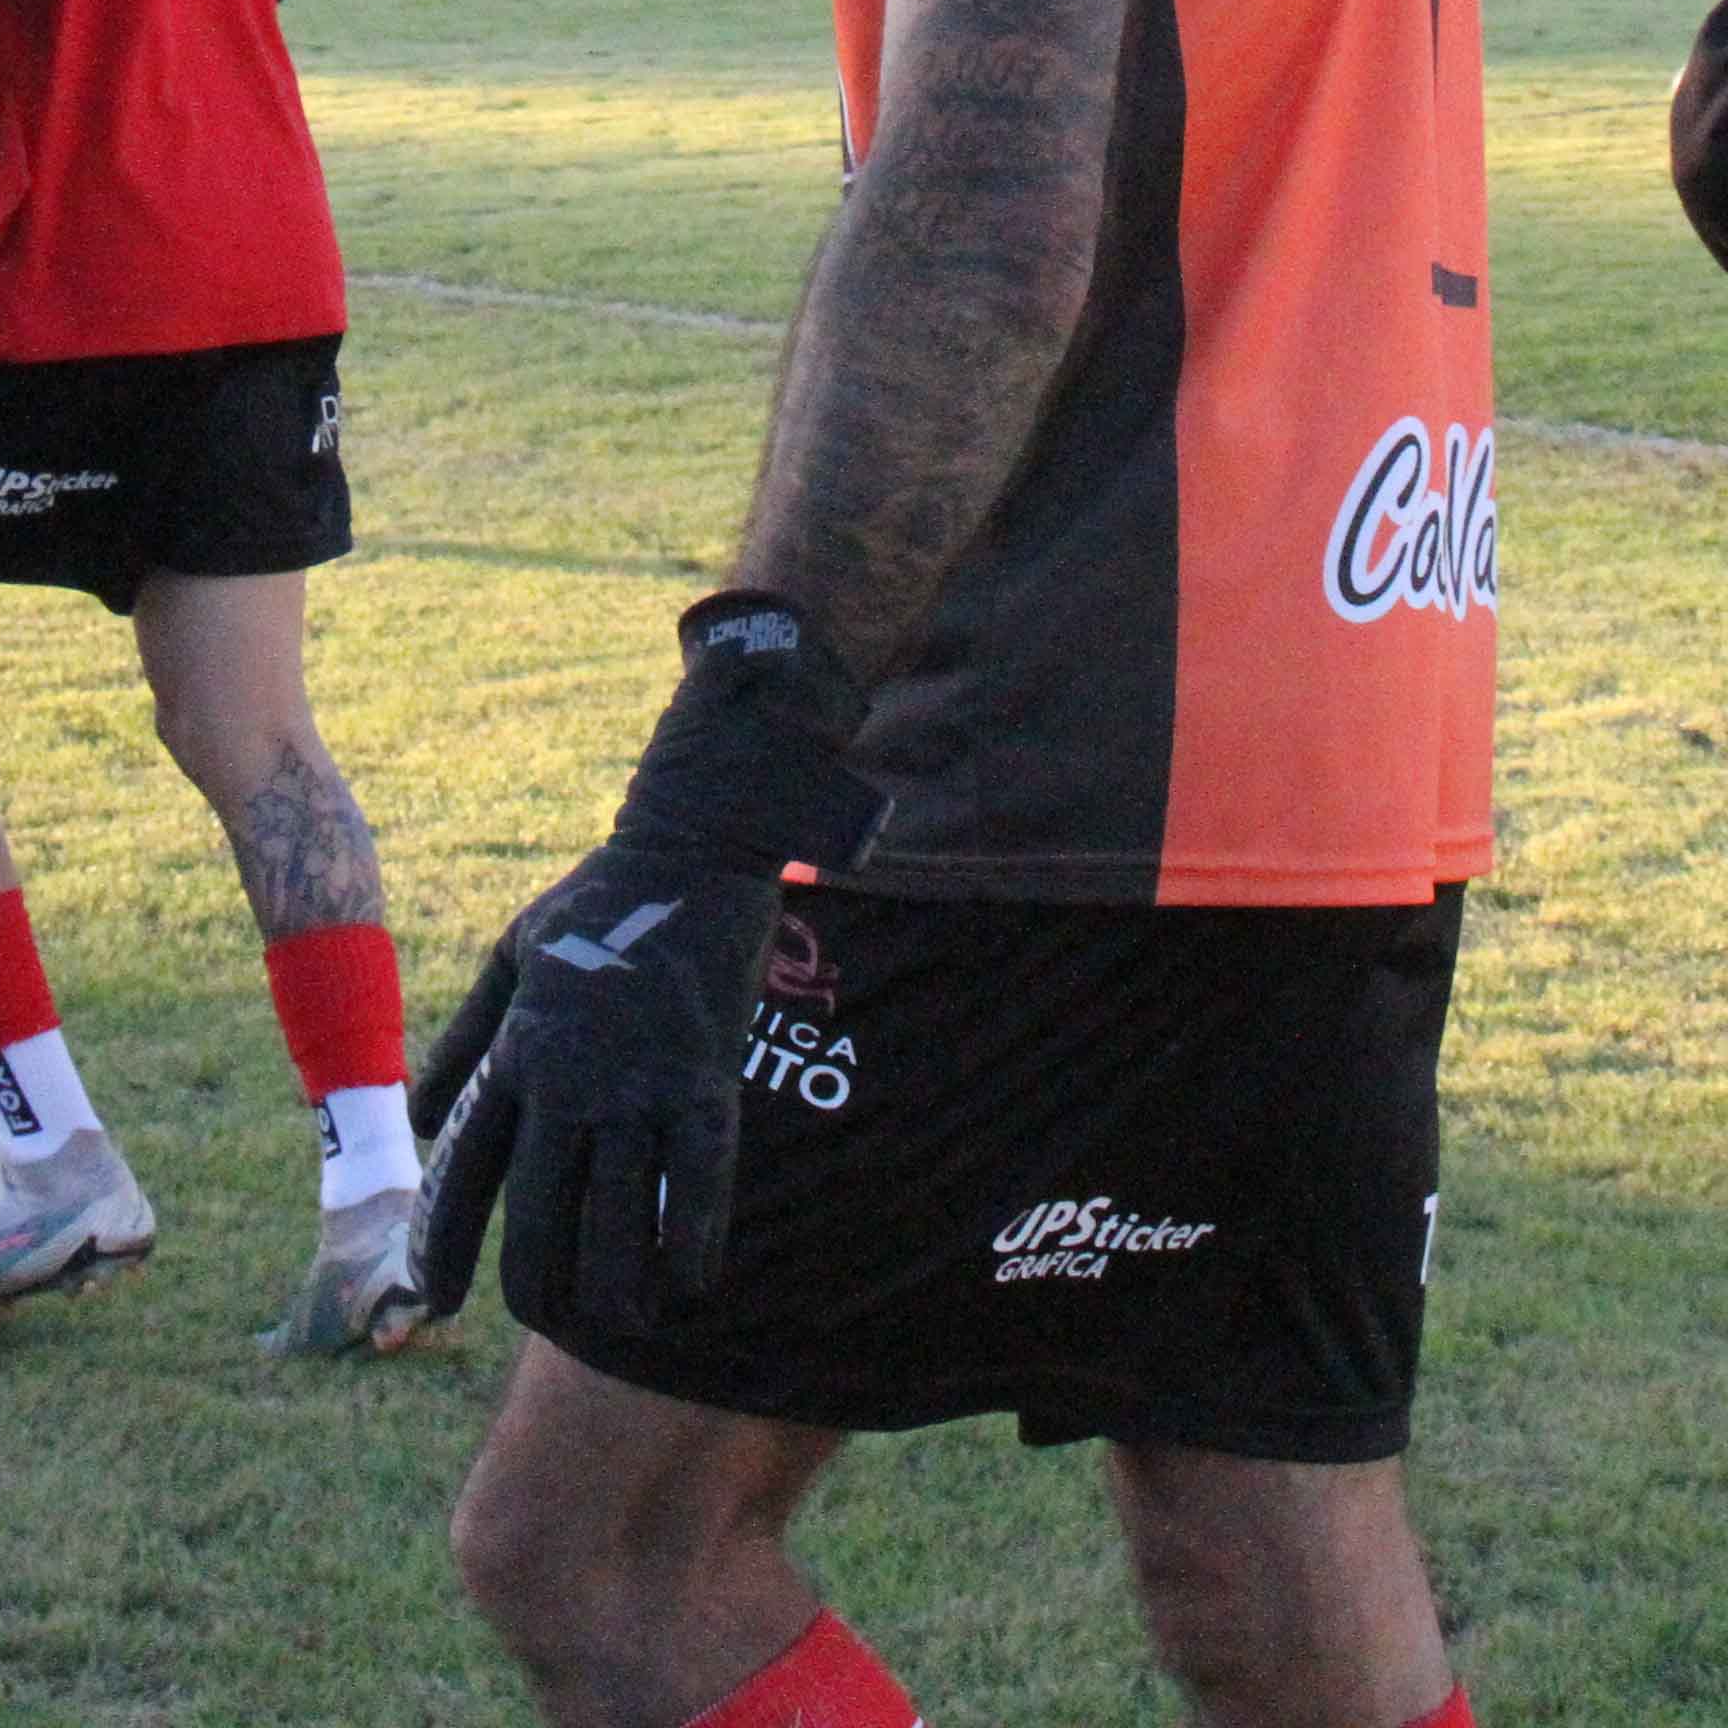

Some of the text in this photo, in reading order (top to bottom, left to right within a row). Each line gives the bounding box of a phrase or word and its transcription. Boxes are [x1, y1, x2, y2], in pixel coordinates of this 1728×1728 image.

[743, 1033, 851, 1110] ITO
[993, 1196, 1217, 1253] UPSticker
[995, 1250, 1109, 1282] GRAFICA
